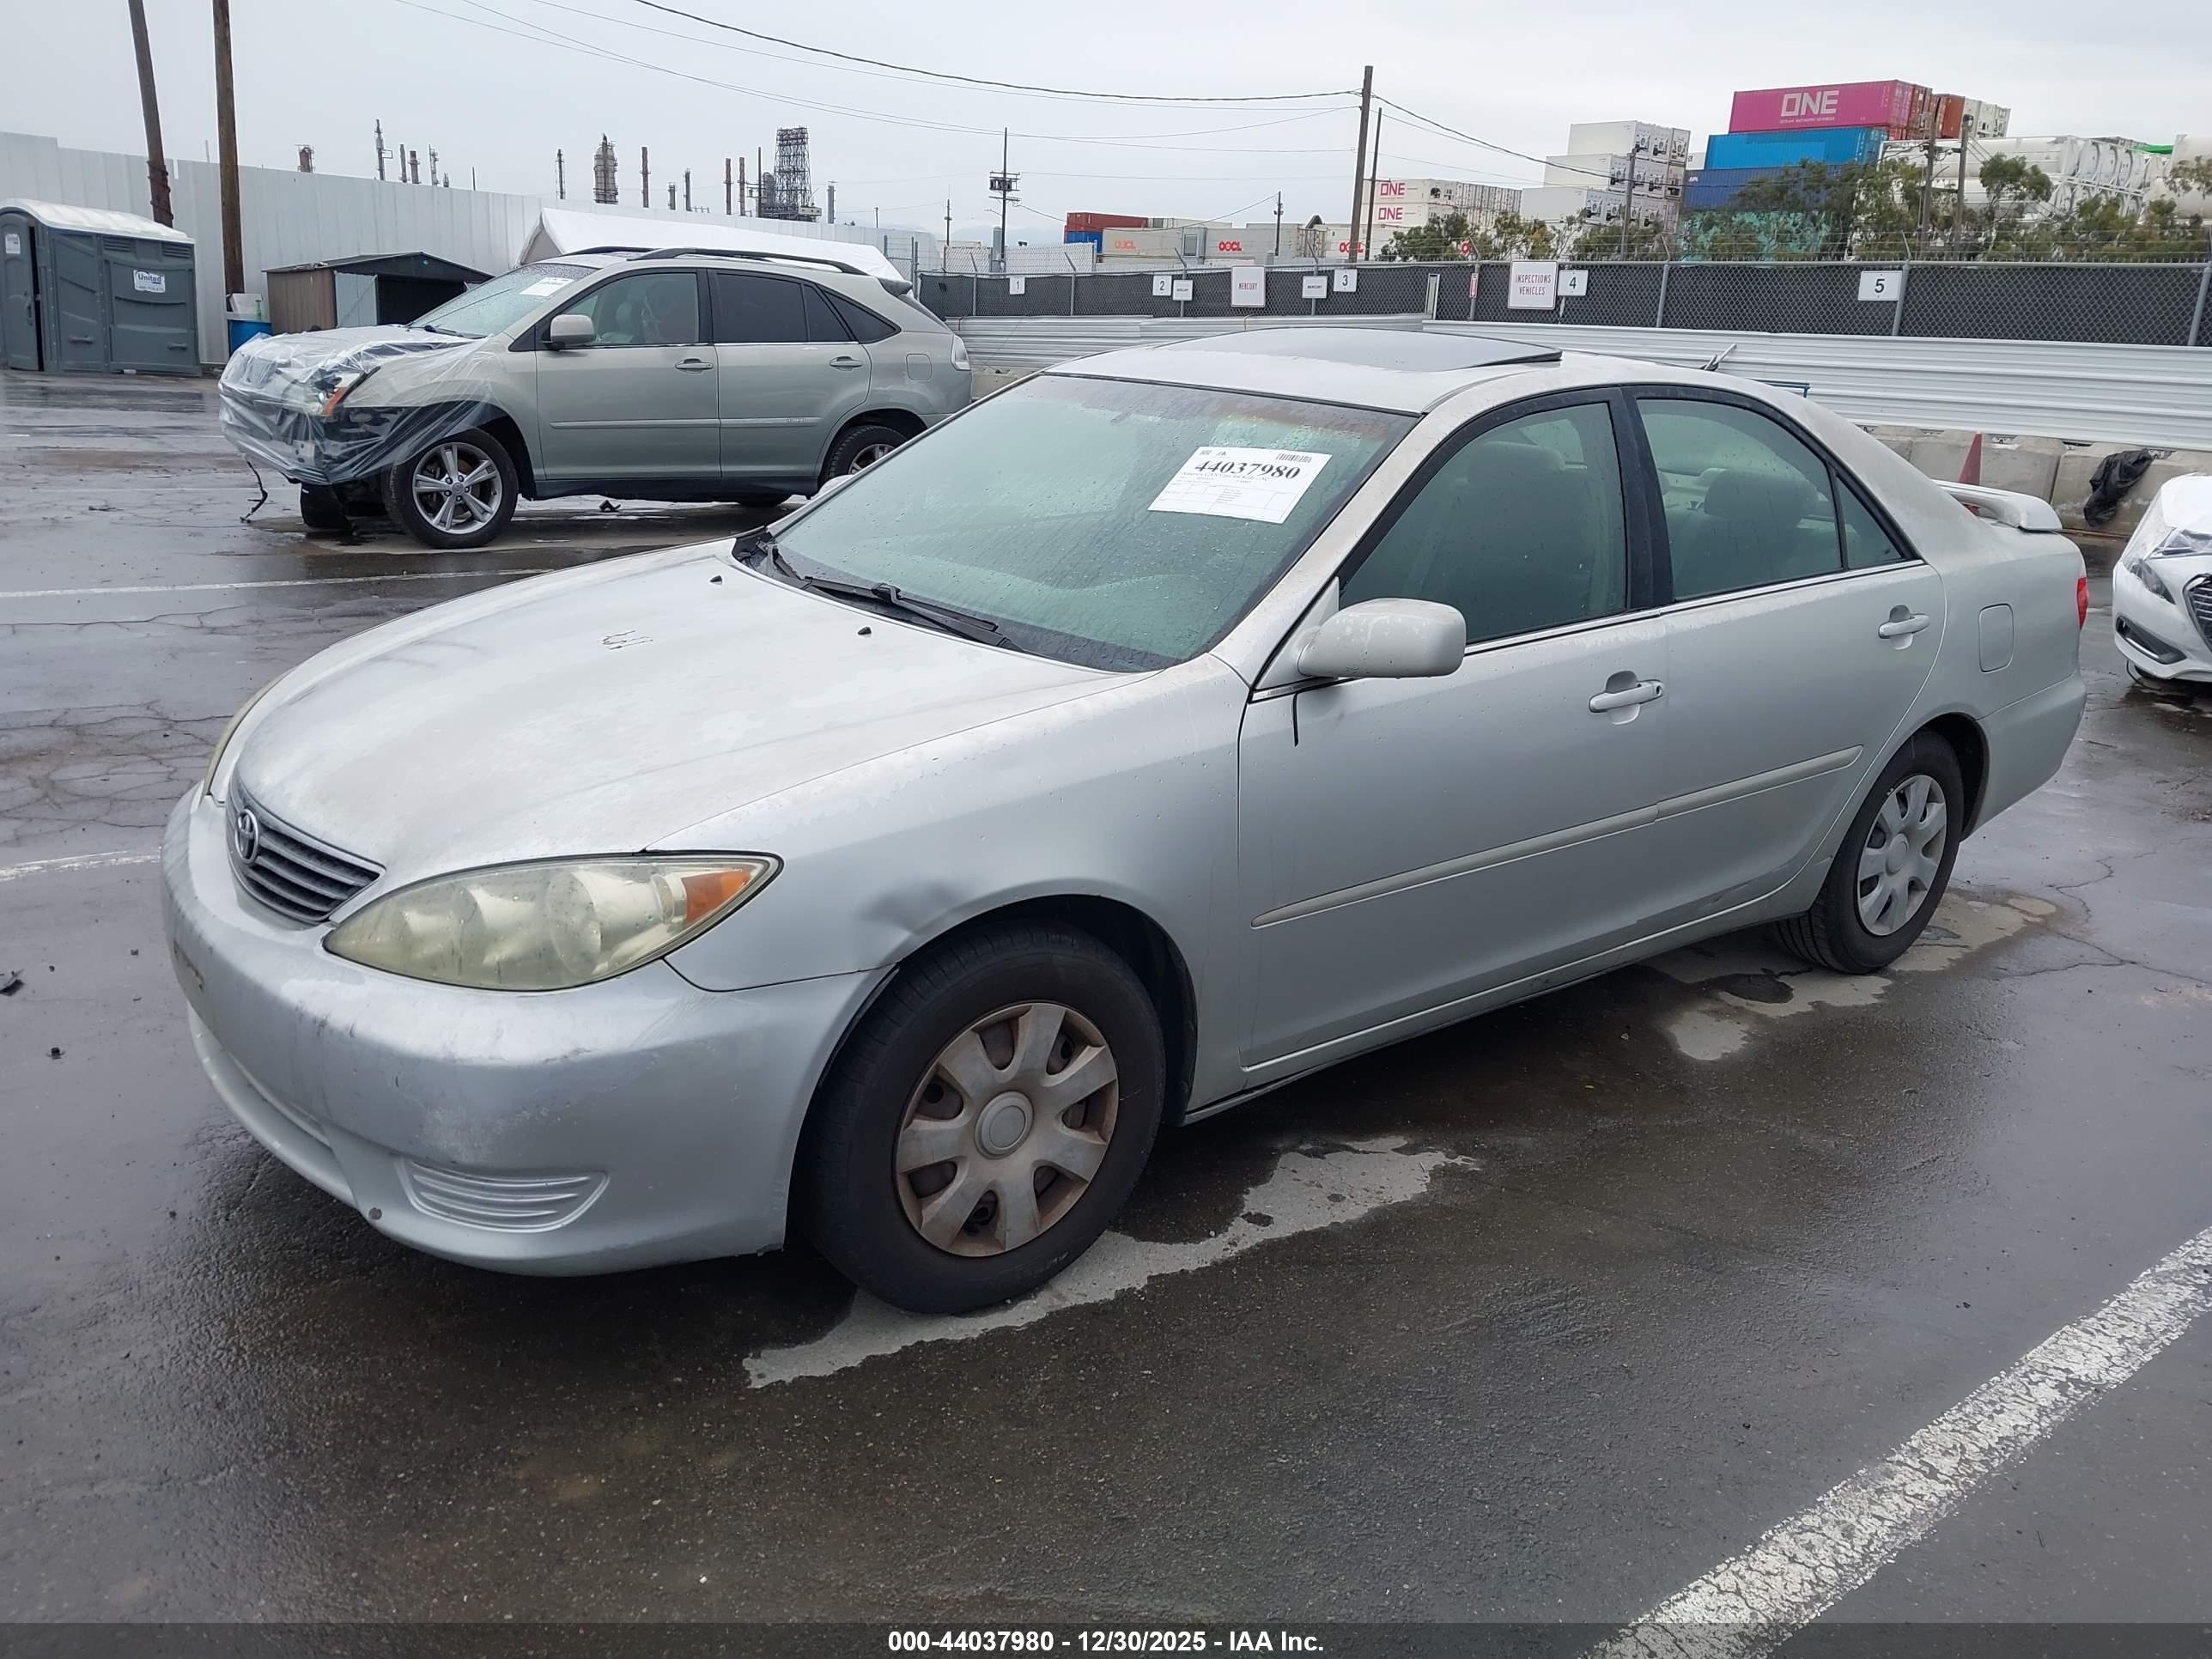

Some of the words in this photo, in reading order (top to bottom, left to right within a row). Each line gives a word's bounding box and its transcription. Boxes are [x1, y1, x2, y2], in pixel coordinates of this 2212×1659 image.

[1781, 90, 1839, 117] ONE
[1380, 183, 1406, 196] ONE
[1378, 207, 1403, 220] ONE
[137, 273, 161, 283] United
[1342, 274, 1348, 286] 3
[1515, 274, 1553, 283] INSPECTIONS
[1569, 276, 1577, 289] 4
[1159, 280, 1165, 291] 2
[1519, 286, 1547, 295] VEHICLES
[1875, 278, 1885, 293] 5
[1194, 460, 1301, 479] 44037980
